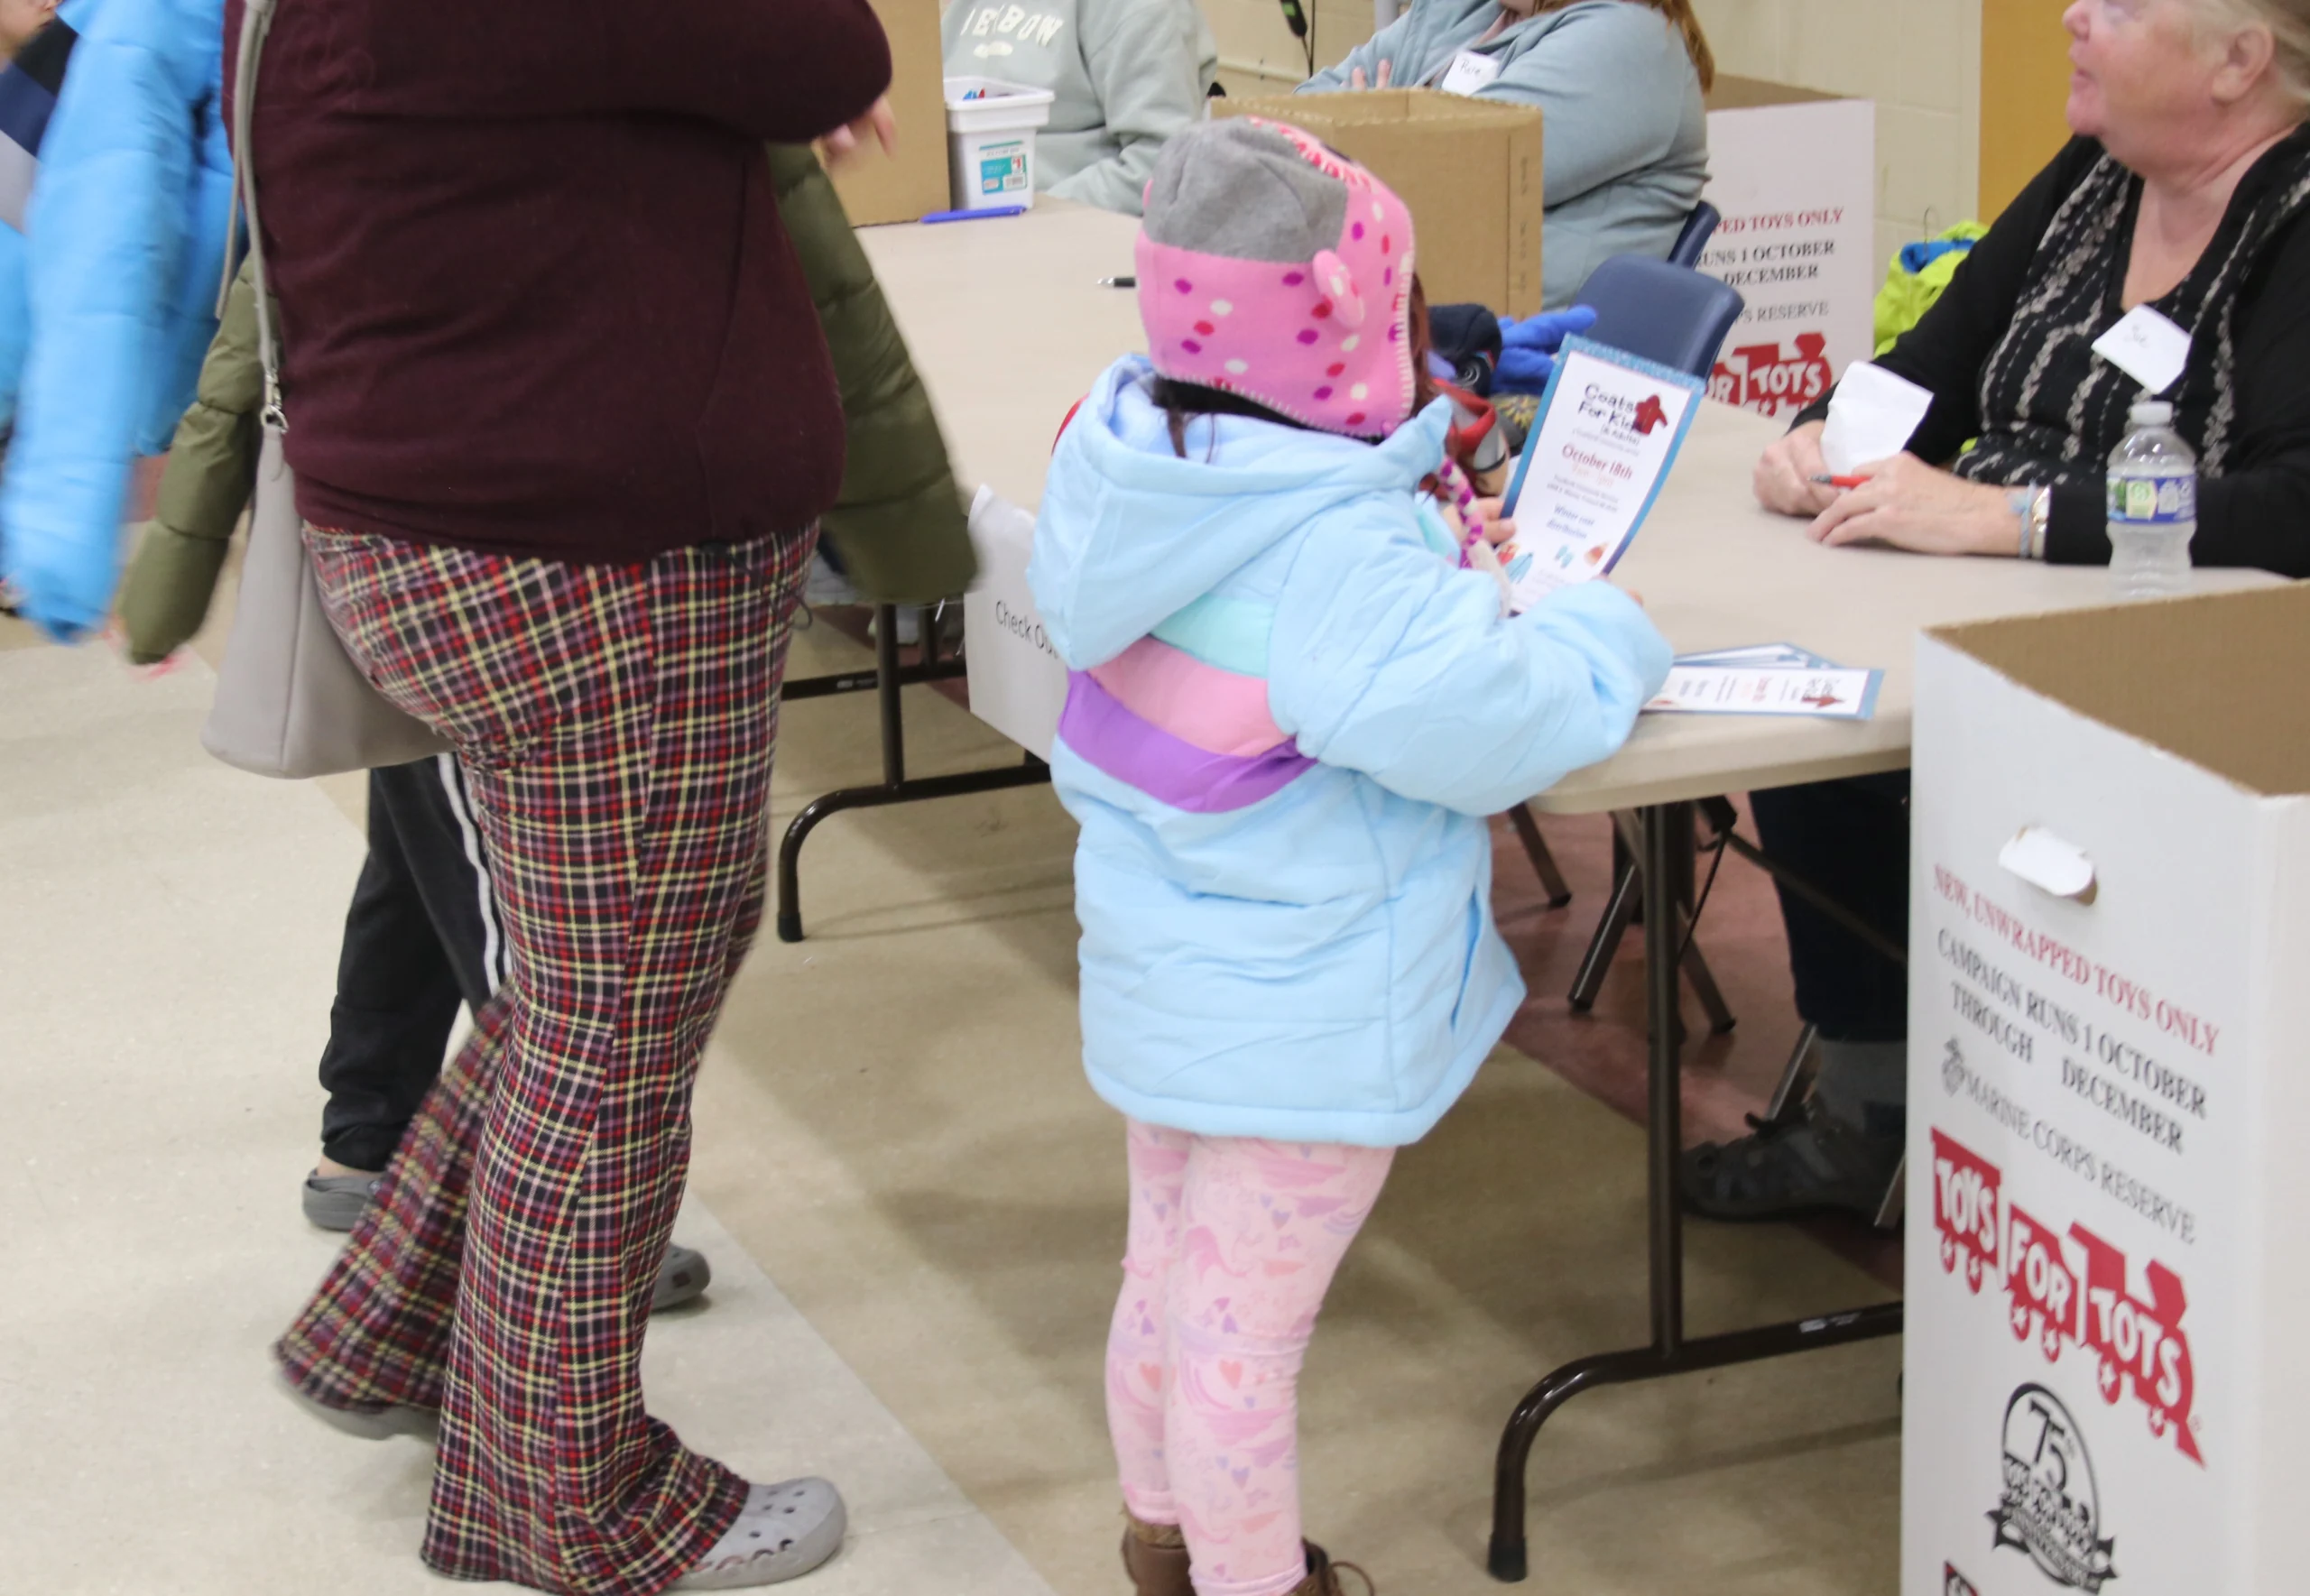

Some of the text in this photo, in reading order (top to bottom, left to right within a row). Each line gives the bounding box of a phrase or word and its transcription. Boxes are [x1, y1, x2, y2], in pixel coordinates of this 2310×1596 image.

[1750, 214, 1794, 233] TOYS
[1798, 208, 1844, 228] ONLY
[1697, 249, 1735, 266] UNS
[1753, 240, 1836, 262] OCTOBER
[1723, 264, 1819, 286] DECEMBER
[1757, 302, 1830, 322] RESERVE
[1750, 361, 1823, 398] TOTS
[1578, 401, 1606, 419] For
[1585, 383, 1634, 413] Coats
[1562, 443, 1607, 471] October
[995, 600, 1031, 642] Check
[1973, 892, 2090, 985] UNWRAPPED
[2093, 964, 2150, 1020] TOYS
[2156, 1000, 2219, 1056] ONLY
[1937, 928, 2021, 1010] CAMPAIGN
[2026, 992, 2078, 1045] RUNS
[2099, 1032, 2207, 1120] OCTOBER
[1951, 982, 2184, 1155] THROUGH DECEMBER
[1966, 1070, 2196, 1245] MARINE CORPS RESERVE
[1936, 1157, 2181, 1407] TOYS FOR TOTS
